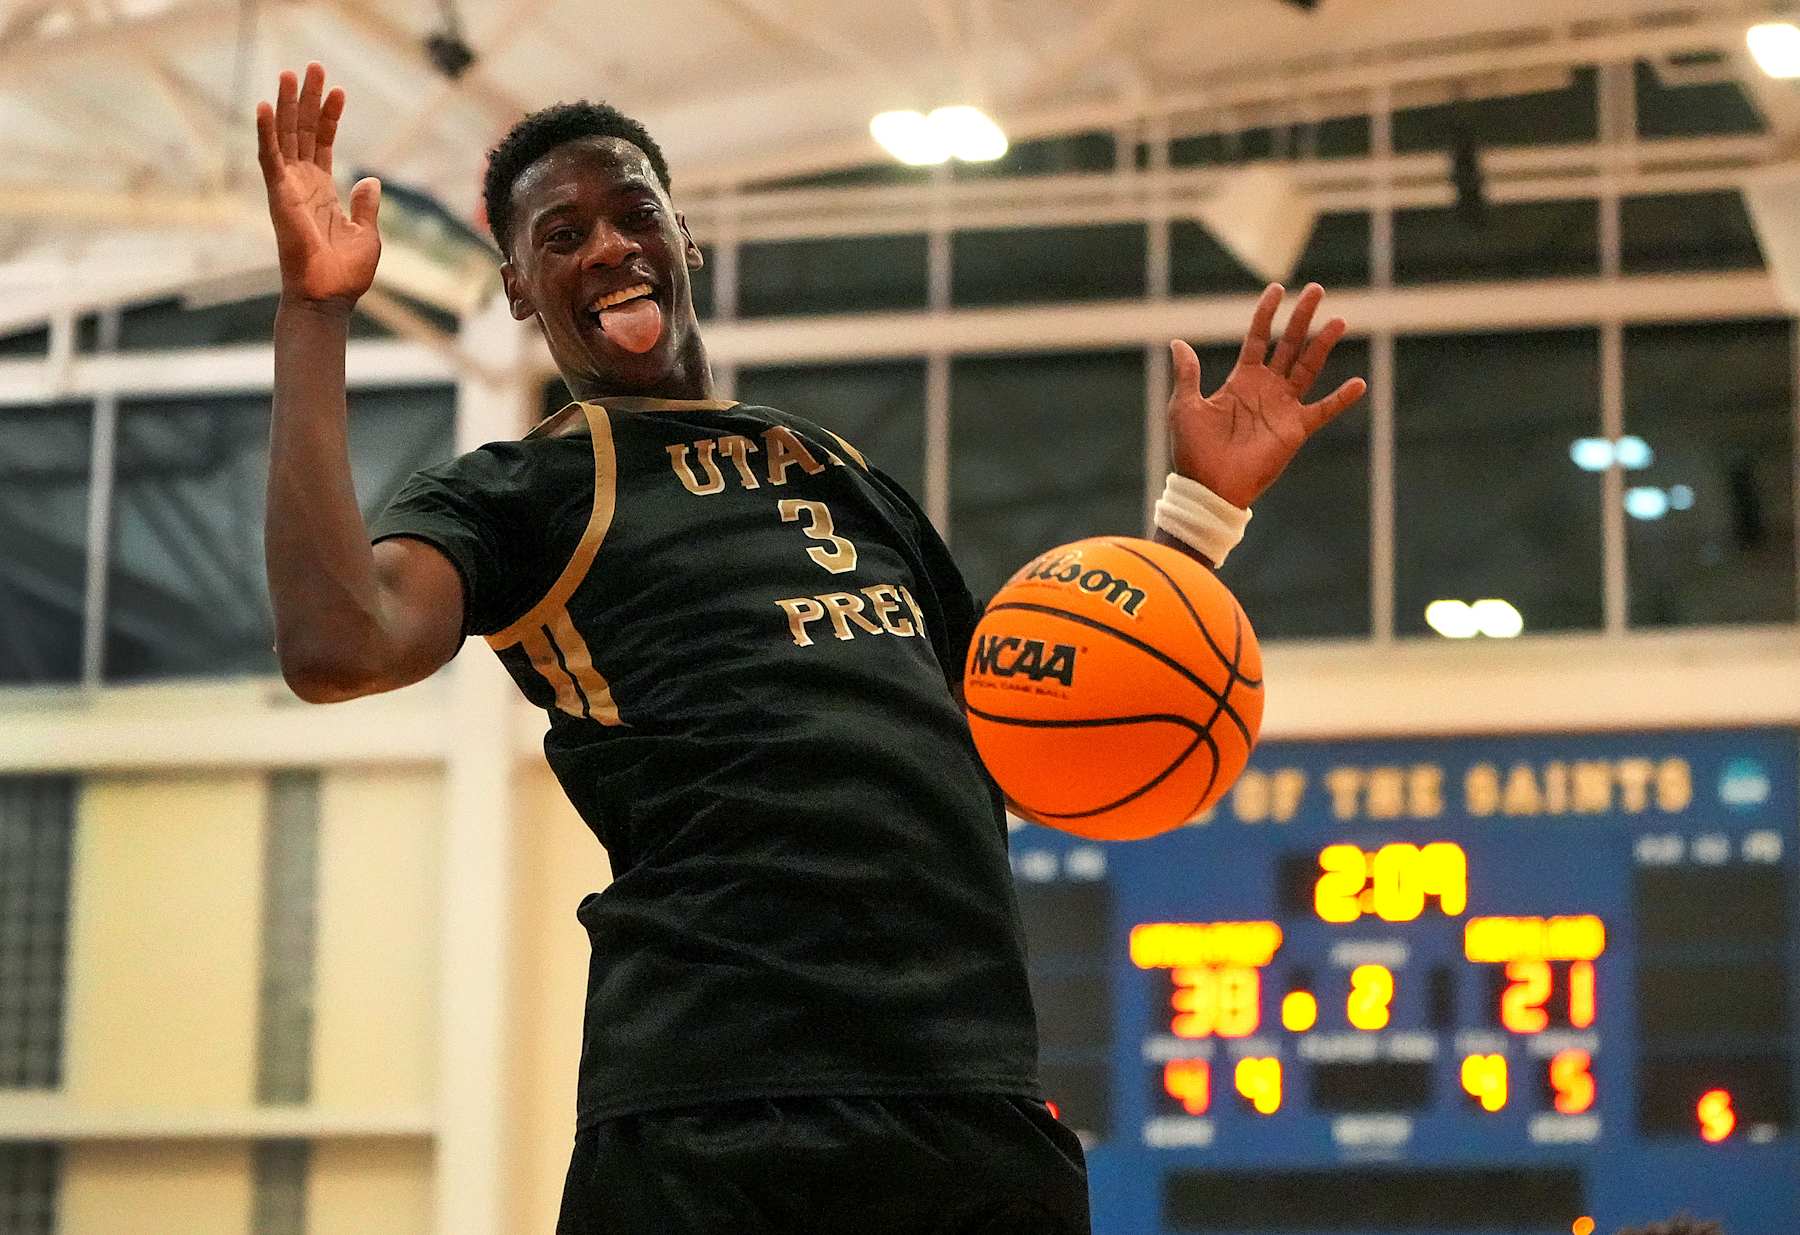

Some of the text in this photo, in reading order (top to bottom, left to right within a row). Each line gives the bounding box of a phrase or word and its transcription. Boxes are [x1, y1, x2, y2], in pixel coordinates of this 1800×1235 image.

[665, 425, 846, 496] UTA
[777, 499, 858, 574] 3
[970, 633, 1078, 687] NCAA
[1324, 763, 1443, 820] THE
[1463, 756, 1693, 818] SAINTS
[1502, 960, 1596, 1034] 21
